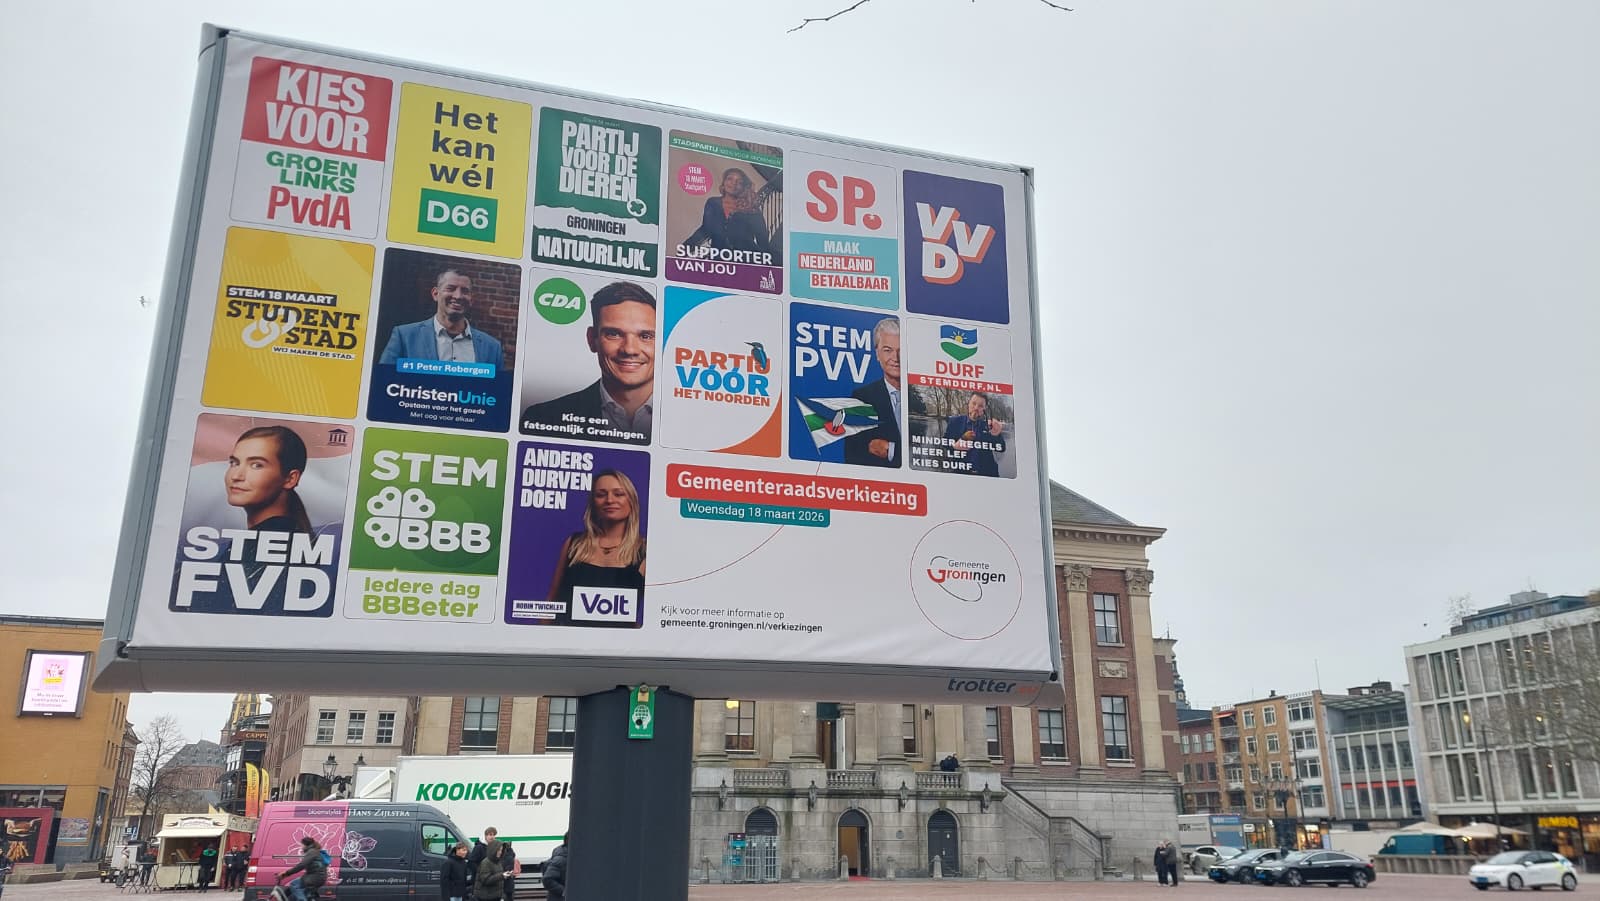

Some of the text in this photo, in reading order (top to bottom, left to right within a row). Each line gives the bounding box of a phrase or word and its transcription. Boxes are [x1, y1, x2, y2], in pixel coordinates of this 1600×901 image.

[276, 65, 366, 114] KIES
[265, 102, 369, 154] VOOR
[434, 102, 498, 134] Het
[432, 130, 496, 161] kan
[562, 120, 640, 157] PARTIJ
[266, 151, 358, 178] GROEN
[562, 145, 638, 178] VOOR DE
[280, 169, 356, 194] LINKS
[429, 163, 494, 190] wél
[559, 166, 638, 202] DIEREN
[267, 186, 351, 230] PvdA
[426, 200, 490, 229] D66
[566, 215, 627, 235] GRONINGEN
[537, 235, 650, 271] NATUURLIJK.
[676, 243, 773, 265] SUPPORTER
[823, 240, 860, 254] MAAK
[676, 260, 737, 276] VAN JOU
[800, 254, 873, 272] NEDERLAND
[811, 272, 889, 290] BETAALBAAR
[228, 287, 334, 304] STEM 18 MAART
[537, 292, 582, 311] CDA
[226, 300, 361, 331] STUDENT
[285, 327, 358, 350] STAD
[795, 321, 872, 352] STEM
[416, 363, 442, 371] Peter
[675, 347, 771, 375] PARTIJ
[795, 346, 872, 384] PVV
[935, 360, 985, 379] DURF
[676, 364, 769, 397] VÓÓR
[919, 376, 1002, 393] STEMDURF.NL
[386, 383, 497, 406] ChristenUnie
[398, 401, 431, 411] Opstaan
[673, 387, 771, 408] HET NOORDEN
[523, 421, 647, 441] fatsoenlijk Groningen.
[561, 413, 609, 426] Kies een
[912, 435, 1003, 451] MINDER REGELS
[912, 447, 967, 460] MEER LEF
[370, 450, 498, 489] STEM
[523, 447, 594, 471] ANDERS
[912, 458, 973, 471] KIES DURF
[521, 467, 593, 492] DURVEN
[677, 470, 918, 511] Gemeenteraadsverkiezing
[520, 488, 567, 510] DOEN
[687, 502, 825, 522] Woensdag 18 maart 2026
[183, 526, 336, 566] STEM
[397, 518, 492, 554] BBB
[927, 568, 1006, 584] Groningen
[948, 559, 990, 570] Gemeente
[175, 561, 331, 612] FVD
[364, 576, 481, 599] Iedere dag
[362, 594, 479, 618] BBBeter
[580, 593, 630, 615] Volt
[661, 605, 785, 619] Kijk voor meer informatie op
[660, 619, 823, 633] gemeente.groningen.nl/verkiezingen
[415, 783, 516, 801] KOOIKER
